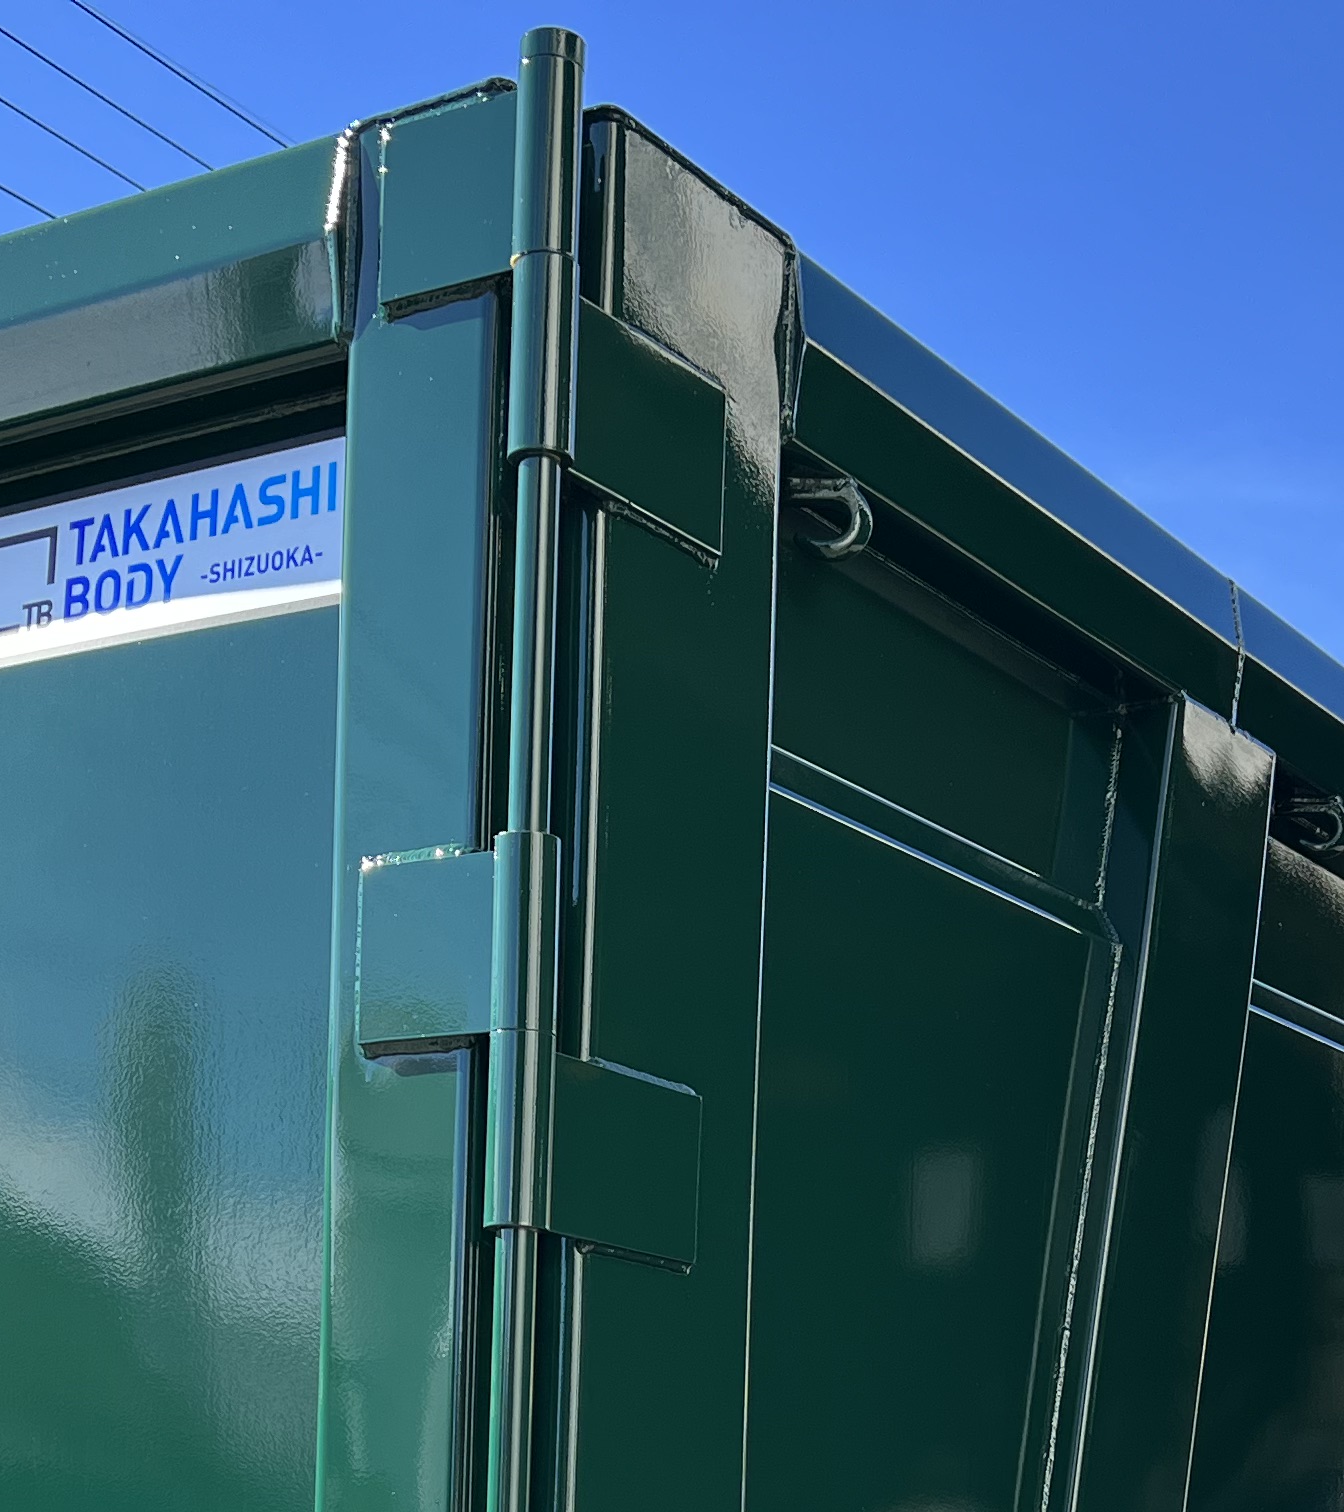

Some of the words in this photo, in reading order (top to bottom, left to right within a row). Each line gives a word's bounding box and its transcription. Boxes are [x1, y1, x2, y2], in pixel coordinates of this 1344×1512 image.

[68, 461, 338, 566] TAKAHASHI
[21, 599, 54, 632] TB
[63, 553, 184, 623] BODY
